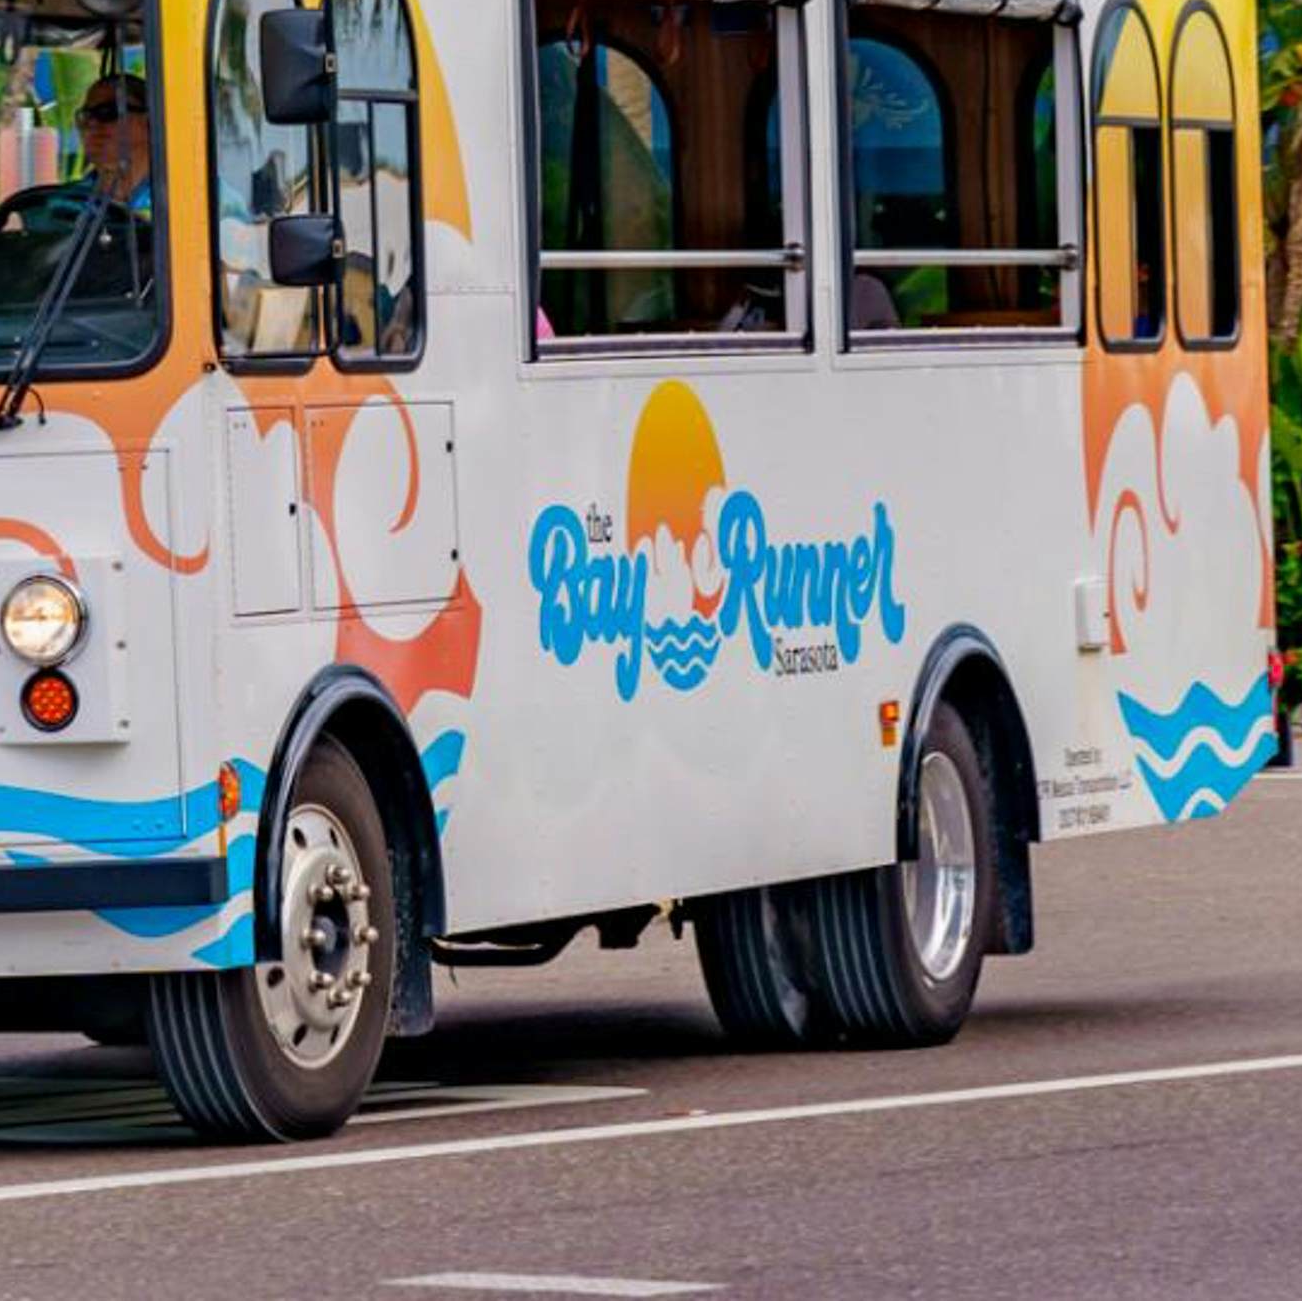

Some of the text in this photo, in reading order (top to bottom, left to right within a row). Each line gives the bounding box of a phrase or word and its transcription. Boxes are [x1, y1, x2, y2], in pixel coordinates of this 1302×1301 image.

[586, 502, 613, 543] the
[528, 491, 905, 703] Bay Runner
[775, 636, 839, 677] Sarasota
